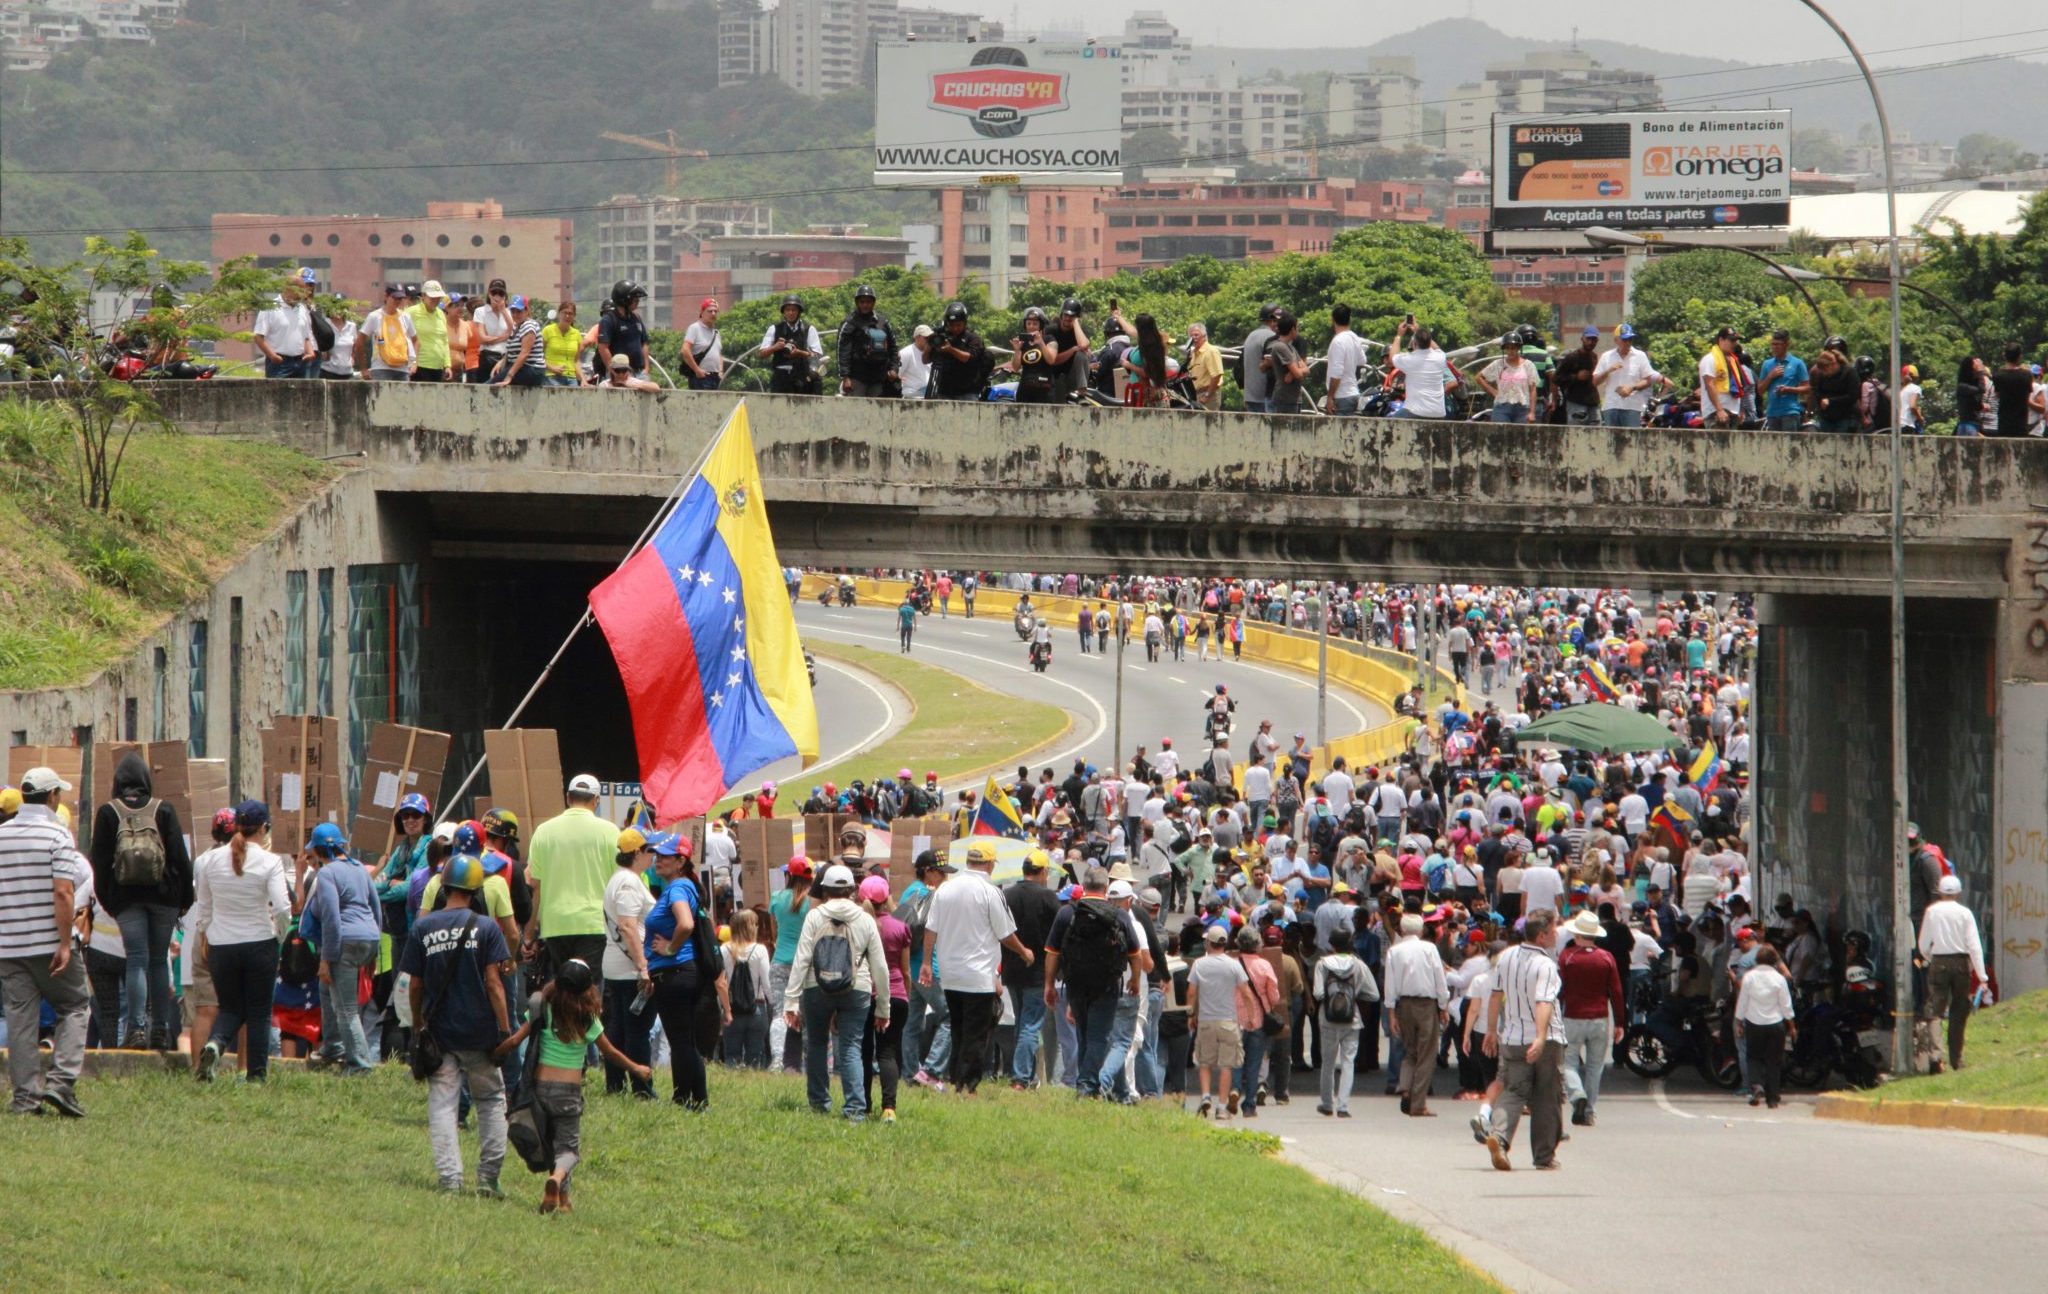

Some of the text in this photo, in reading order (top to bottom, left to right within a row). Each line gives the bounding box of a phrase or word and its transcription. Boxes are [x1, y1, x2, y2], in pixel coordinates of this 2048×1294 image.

[943, 82, 1054, 98] CAUCHOSYA
[983, 110, 1013, 119] .com
[1643, 119, 1784, 132] Bono de Alimentación
[1531, 133, 1583, 146] omega
[877, 148, 1120, 166] WWW.CAUCHOSYA.COM
[1675, 144, 1783, 157] TARJETA
[1675, 157, 1783, 181] omega
[1644, 187, 1782, 201] www.tarjetaomega.com
[1544, 207, 1706, 223] Aceptada en todas partes
[422, 928, 449, 948] #YO
